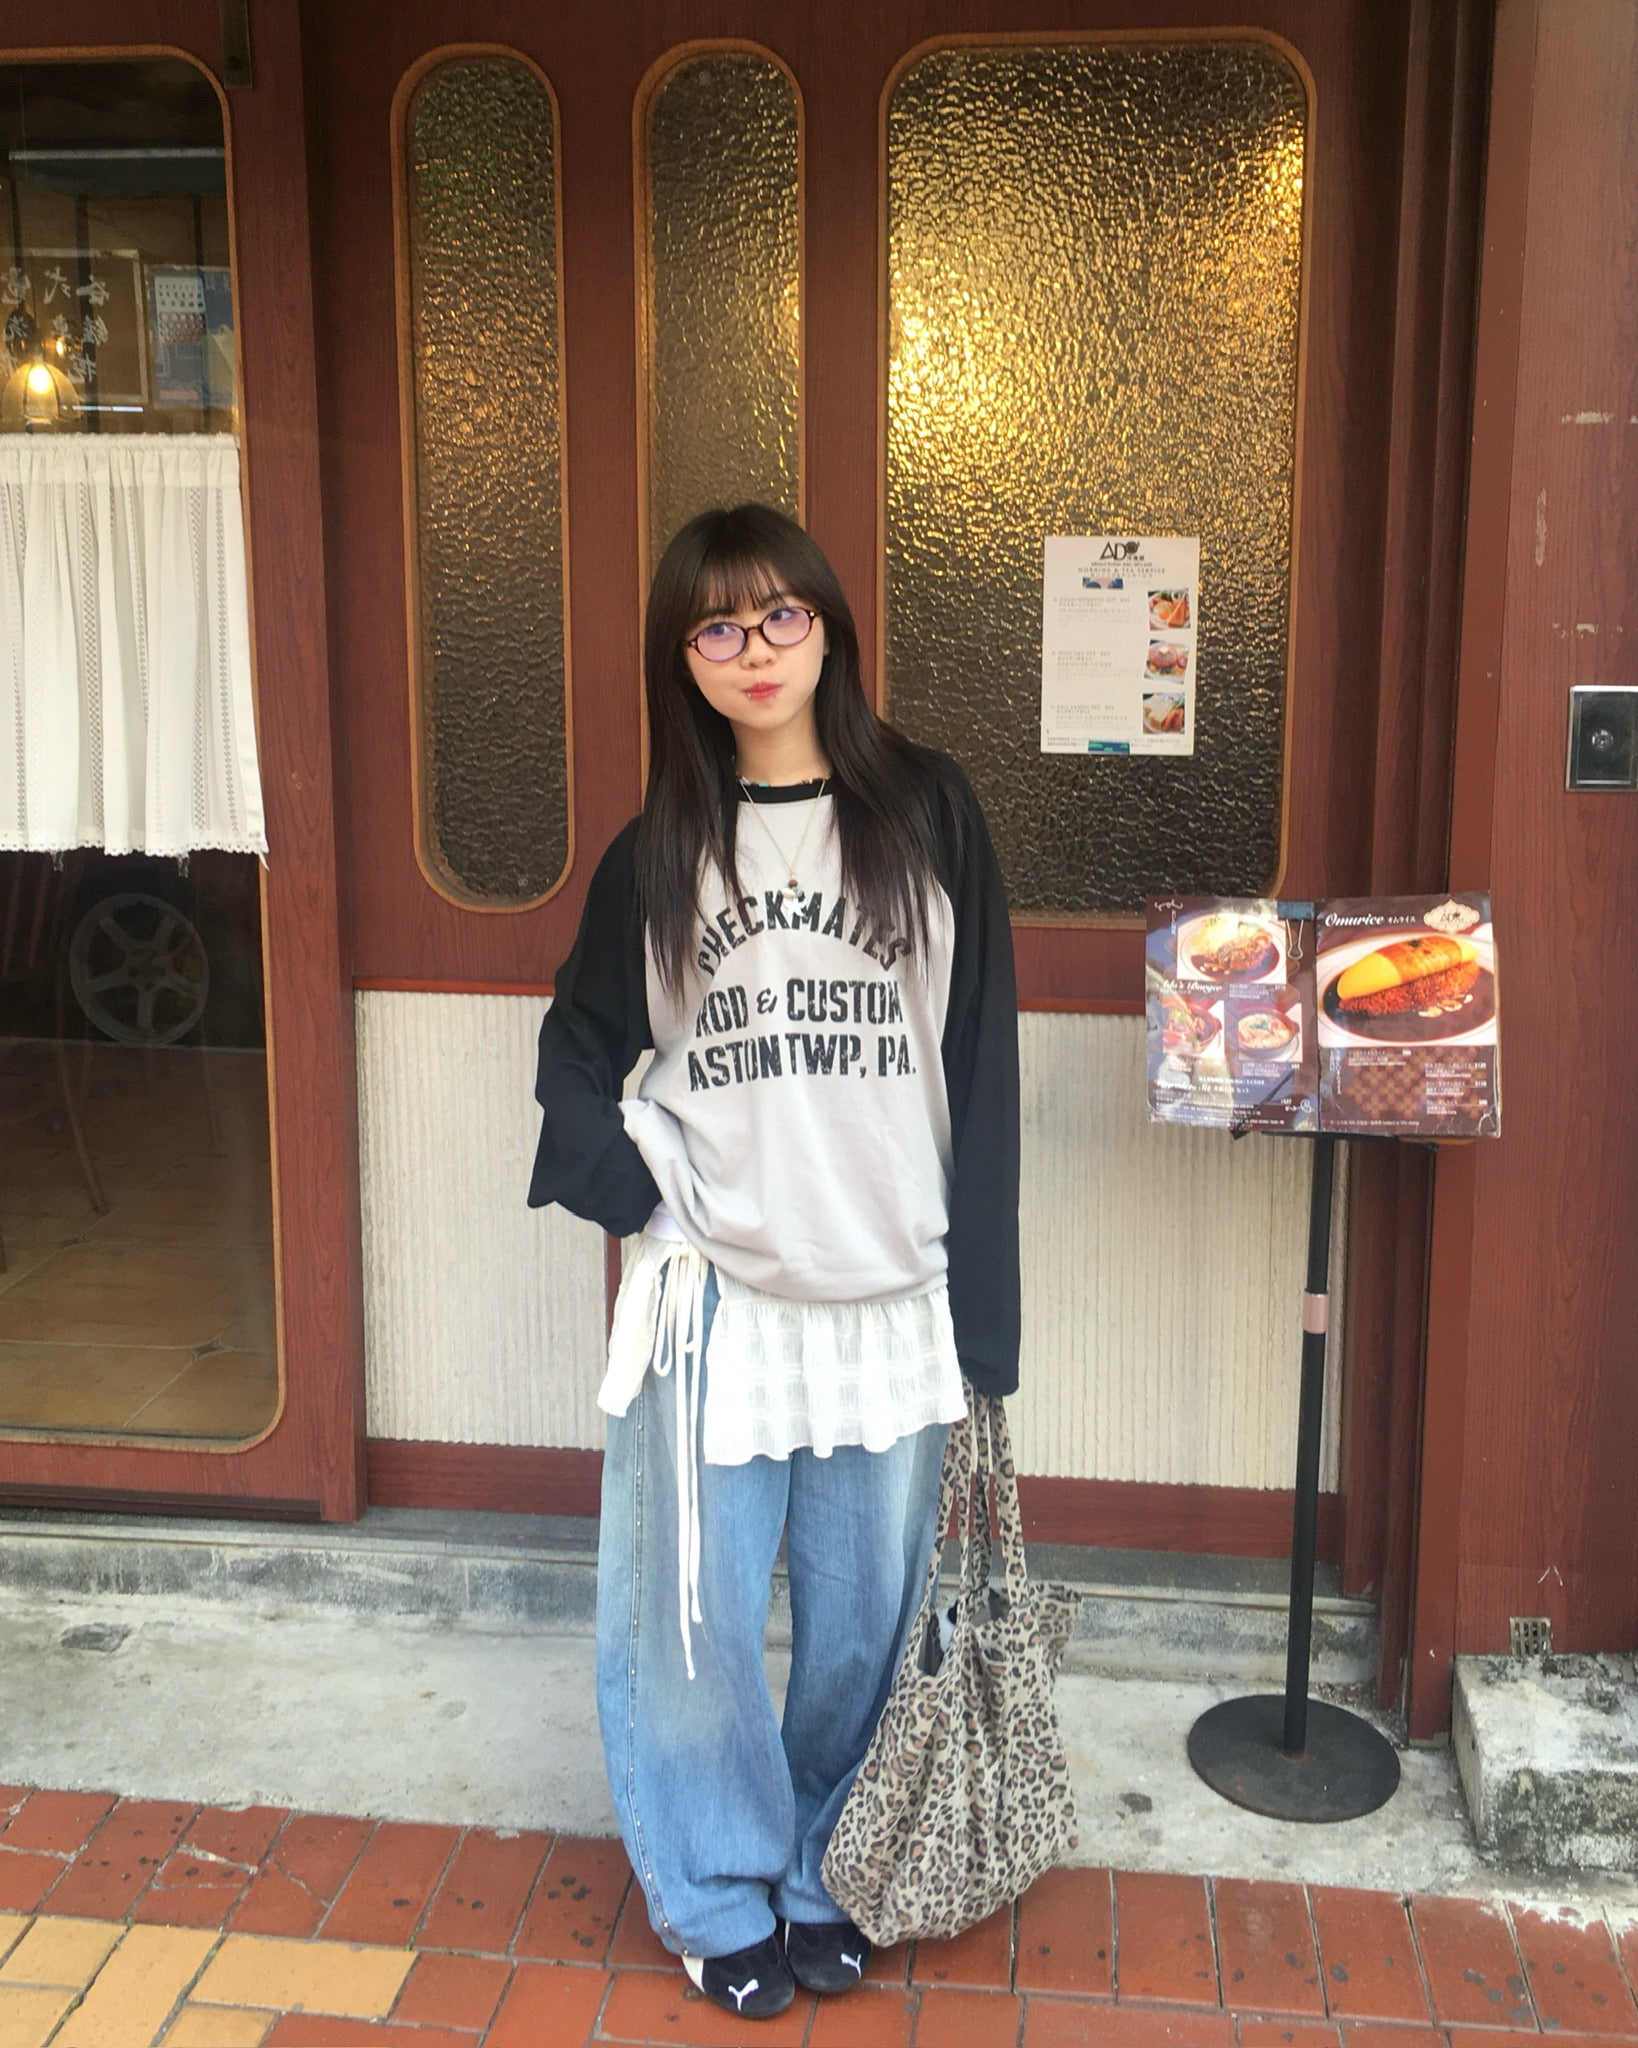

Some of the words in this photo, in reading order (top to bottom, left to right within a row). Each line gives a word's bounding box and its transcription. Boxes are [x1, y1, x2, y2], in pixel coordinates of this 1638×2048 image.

[1324, 912, 1385, 927] Omurice
[756, 987, 778, 1015] &
[786, 978, 903, 1025] CUSTOM
[688, 1034, 783, 1092] ASTON
[785, 1032, 867, 1078] TWP,
[877, 1033, 917, 1077] PA.
